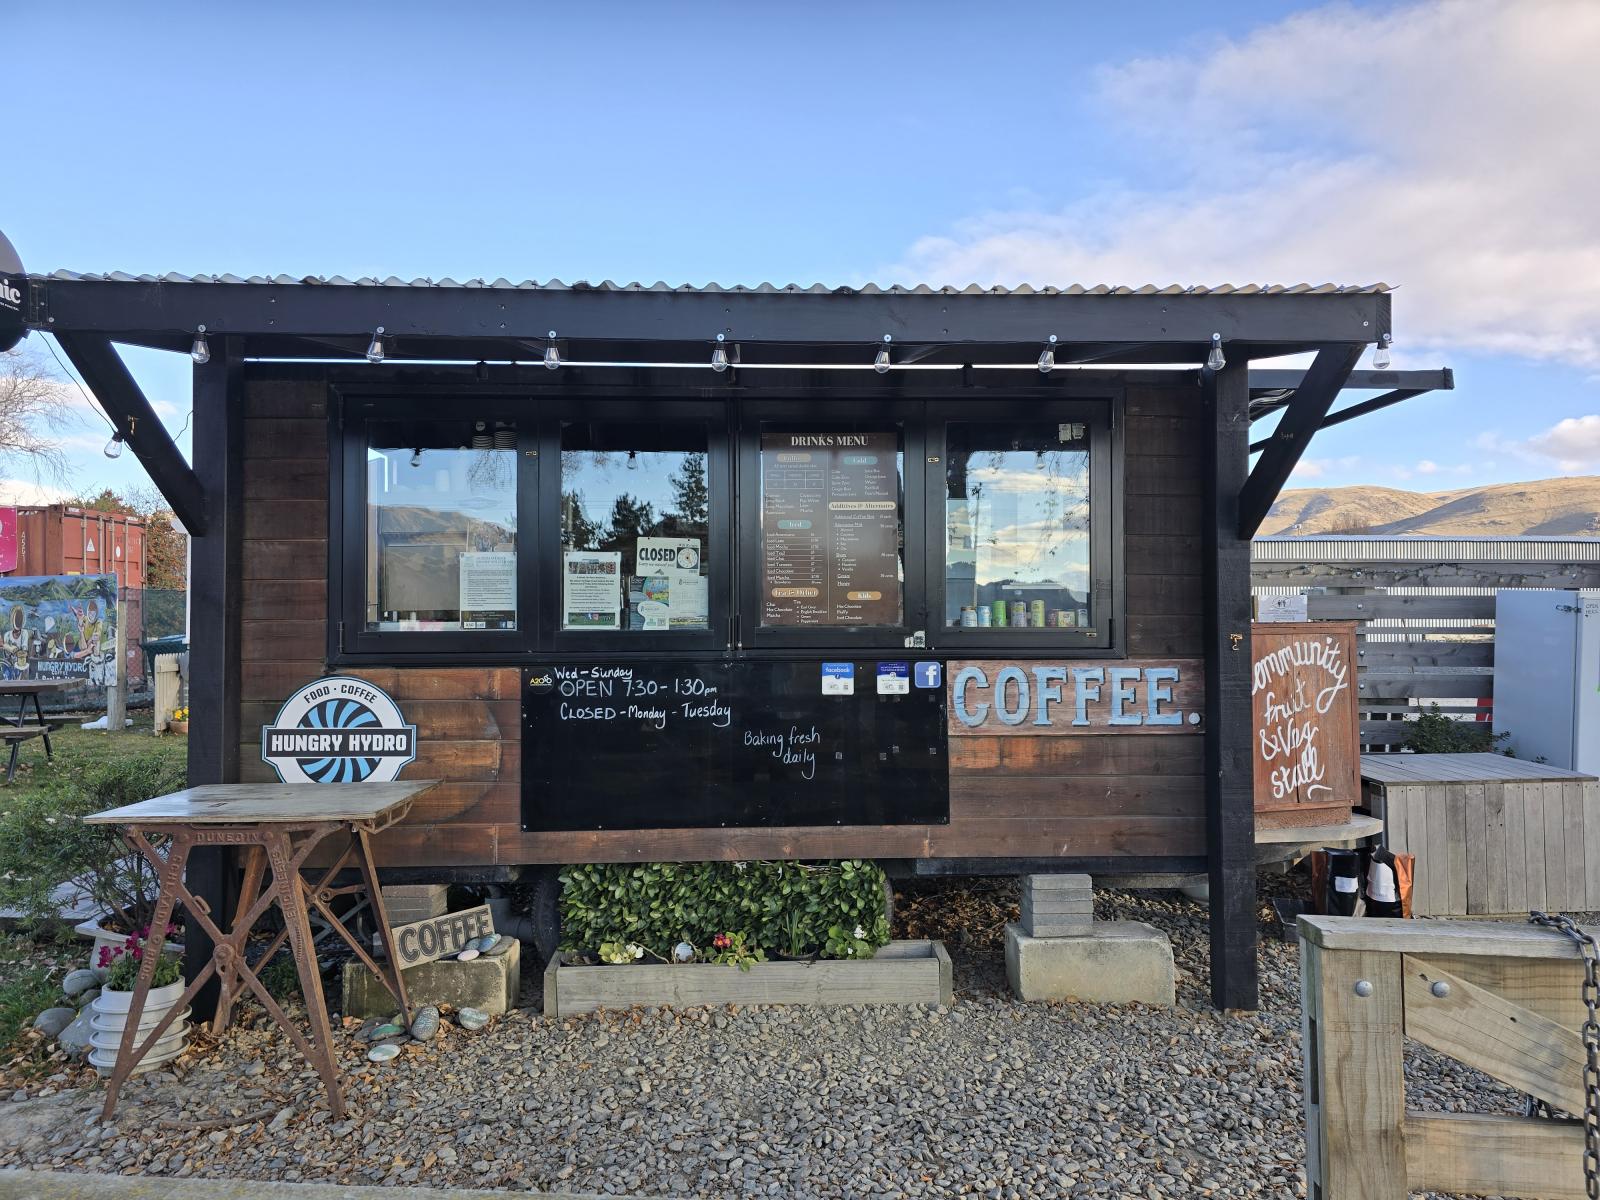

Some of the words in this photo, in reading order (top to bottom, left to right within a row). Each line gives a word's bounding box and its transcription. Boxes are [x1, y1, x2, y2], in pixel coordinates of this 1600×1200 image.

[791, 436, 834, 446] DRINKS
[836, 436, 868, 446] MENU
[639, 548, 676, 562] CLOSED
[554, 667, 578, 680] Wed
[592, 666, 633, 680] Sunday
[1252, 637, 1348, 714] ommunity
[304, 686, 330, 704] FOOD
[341, 684, 378, 704] COFFEE
[560, 680, 613, 696] OPEN
[560, 702, 616, 720] CLOSED
[628, 705, 666, 730] Monday
[682, 700, 730, 727] Tuesday
[272, 734, 343, 752] HUNGRY
[348, 734, 407, 751] HYDRO
[744, 730, 784, 758] Baking
[788, 726, 820, 744] fresh
[783, 747, 816, 780] daily
[197, 832, 258, 842] DUNEDIN
